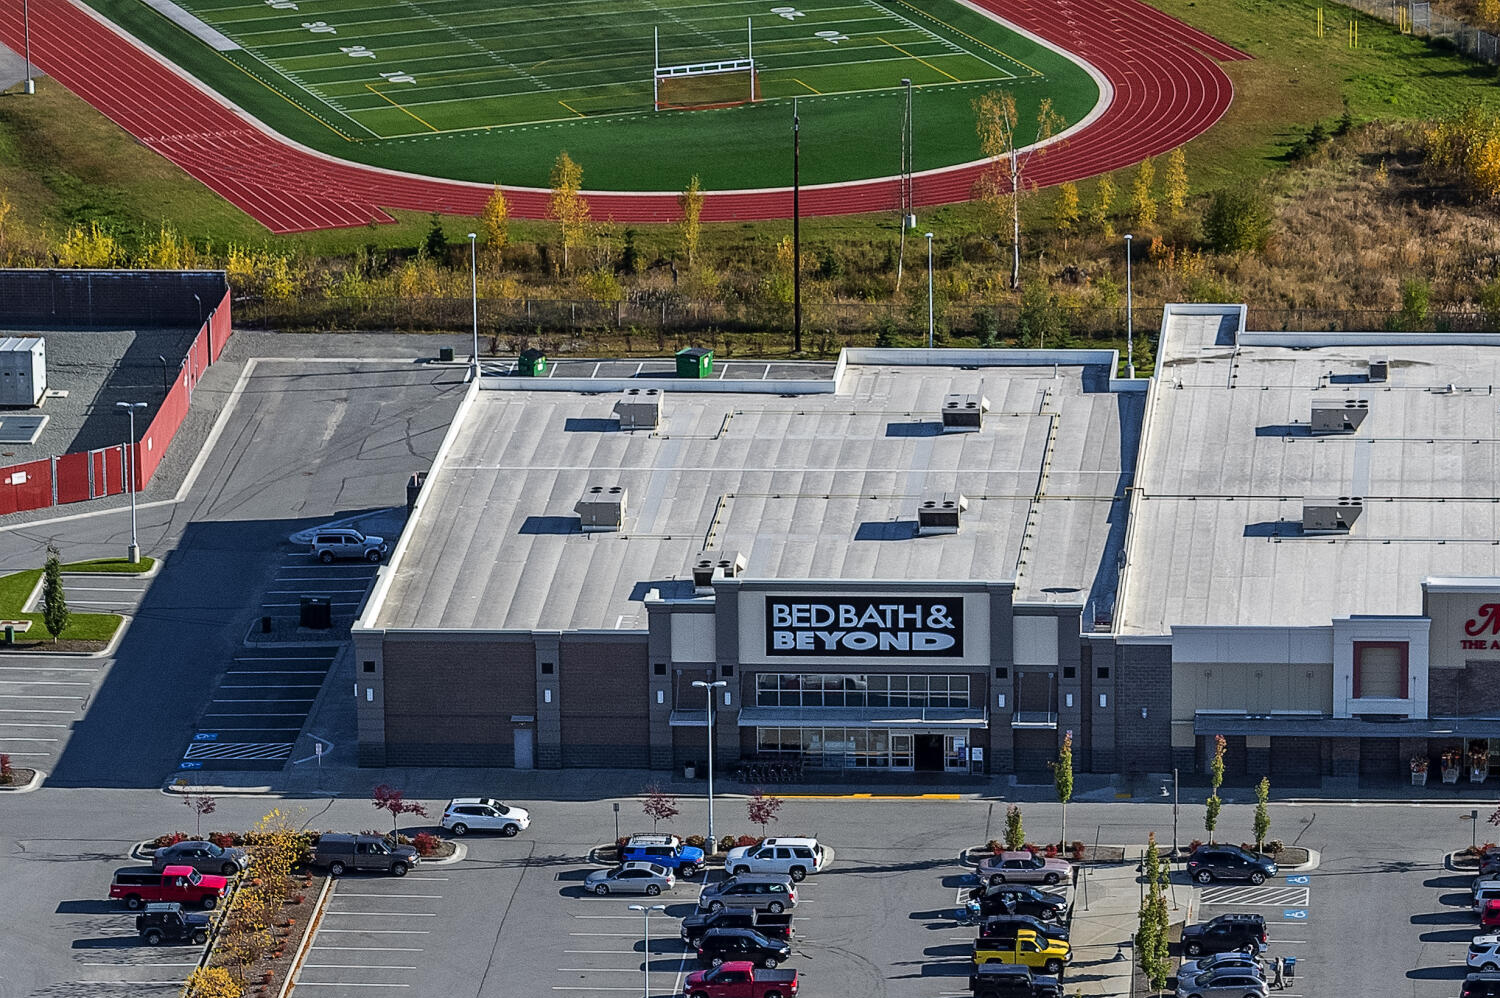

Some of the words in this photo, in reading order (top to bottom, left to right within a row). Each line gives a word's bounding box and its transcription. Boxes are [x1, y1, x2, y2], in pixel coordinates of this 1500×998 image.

[772, 604, 836, 628] BED
[839, 604, 923, 629] BATH
[926, 604, 956, 629] &
[773, 631, 956, 651] BEYOND
[1460, 640, 1488, 650] THE
